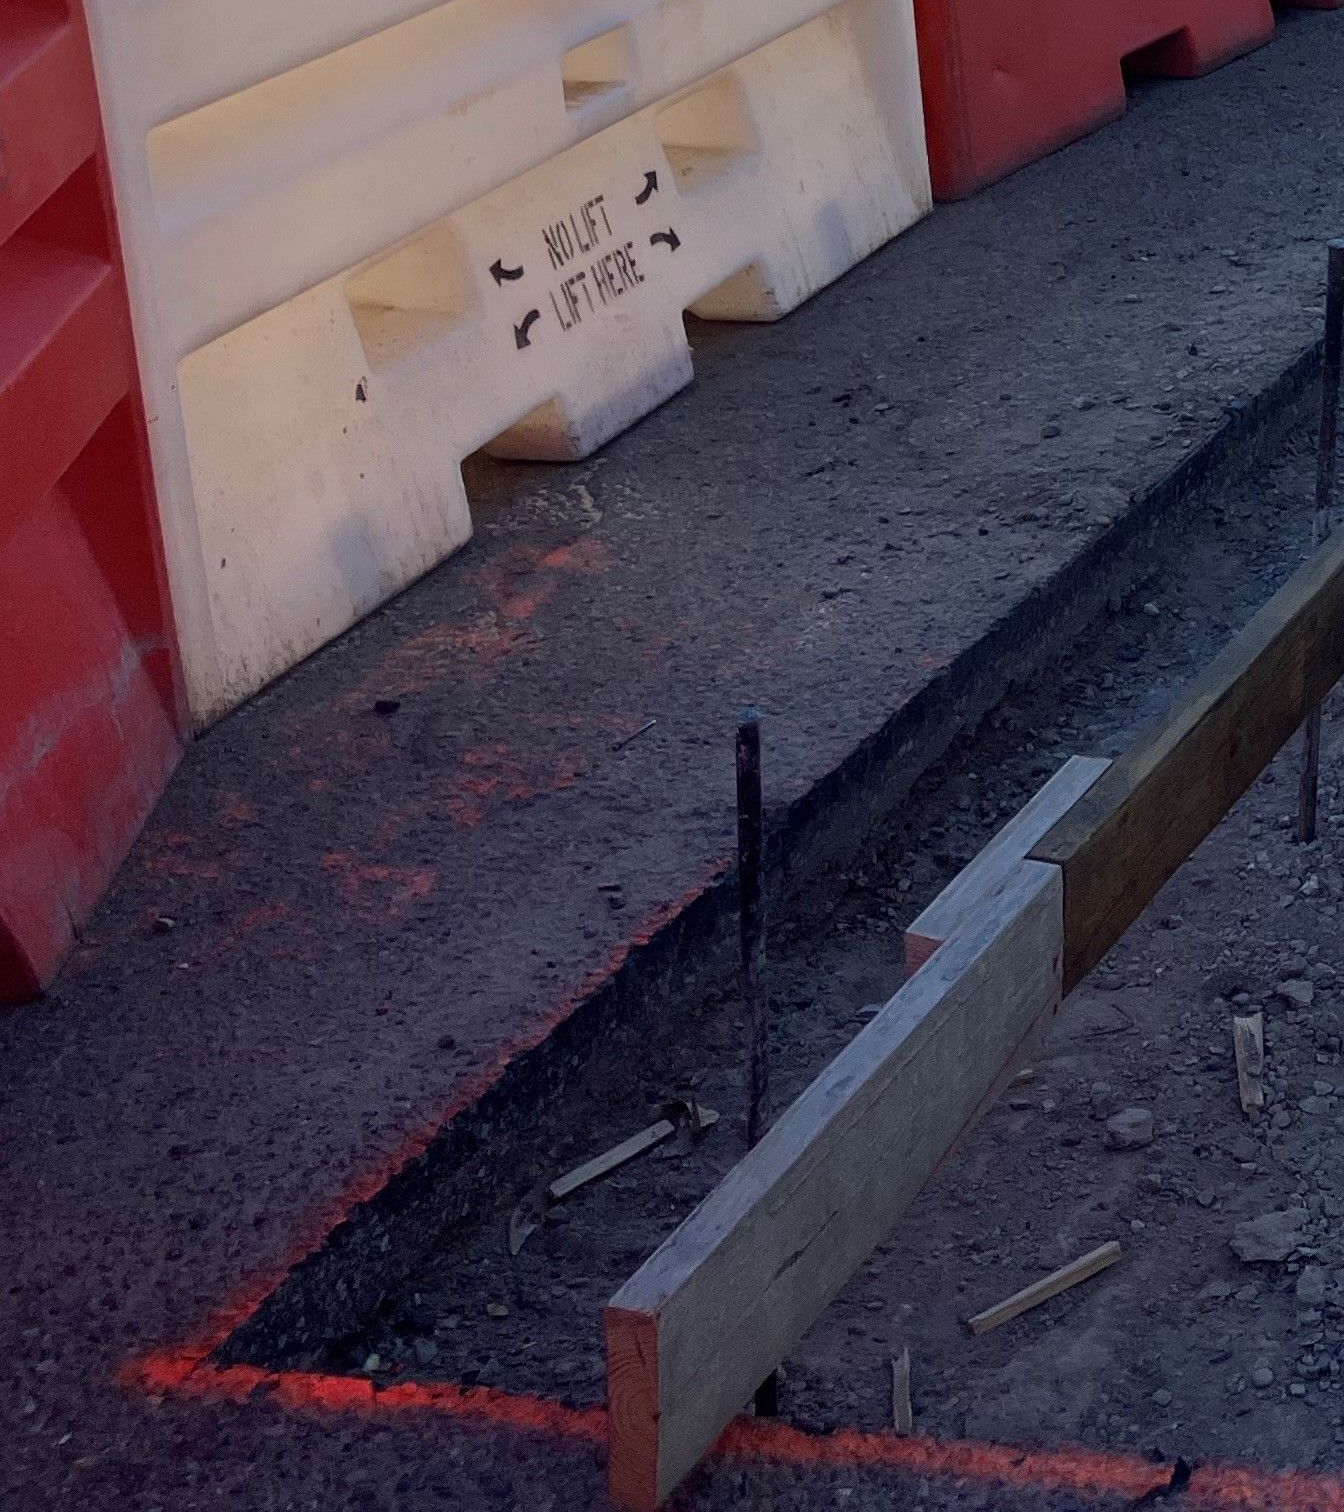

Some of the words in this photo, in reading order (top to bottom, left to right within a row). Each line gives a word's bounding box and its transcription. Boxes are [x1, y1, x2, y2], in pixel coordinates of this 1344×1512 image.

[541, 219, 574, 270] NO
[569, 195, 612, 253] LIFT
[549, 271, 595, 331] LIFT
[590, 241, 644, 305] HERE
